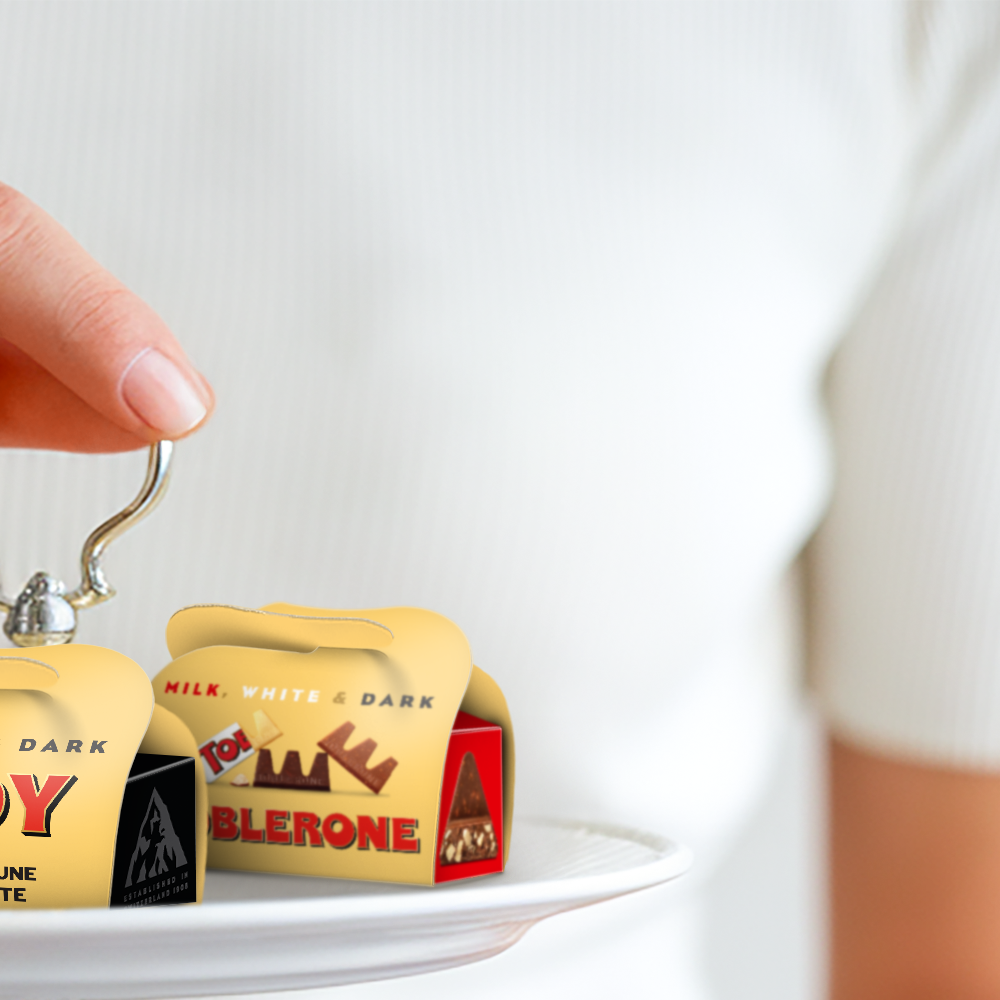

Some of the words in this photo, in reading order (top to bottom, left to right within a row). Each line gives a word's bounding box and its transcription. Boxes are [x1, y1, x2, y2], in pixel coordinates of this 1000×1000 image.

[242, 686, 320, 703] WHITE
[333, 692, 346, 704] &
[361, 693, 435, 709] DARK
[18, 738, 108, 754] DARK
[205, 805, 421, 854] BLERONE
